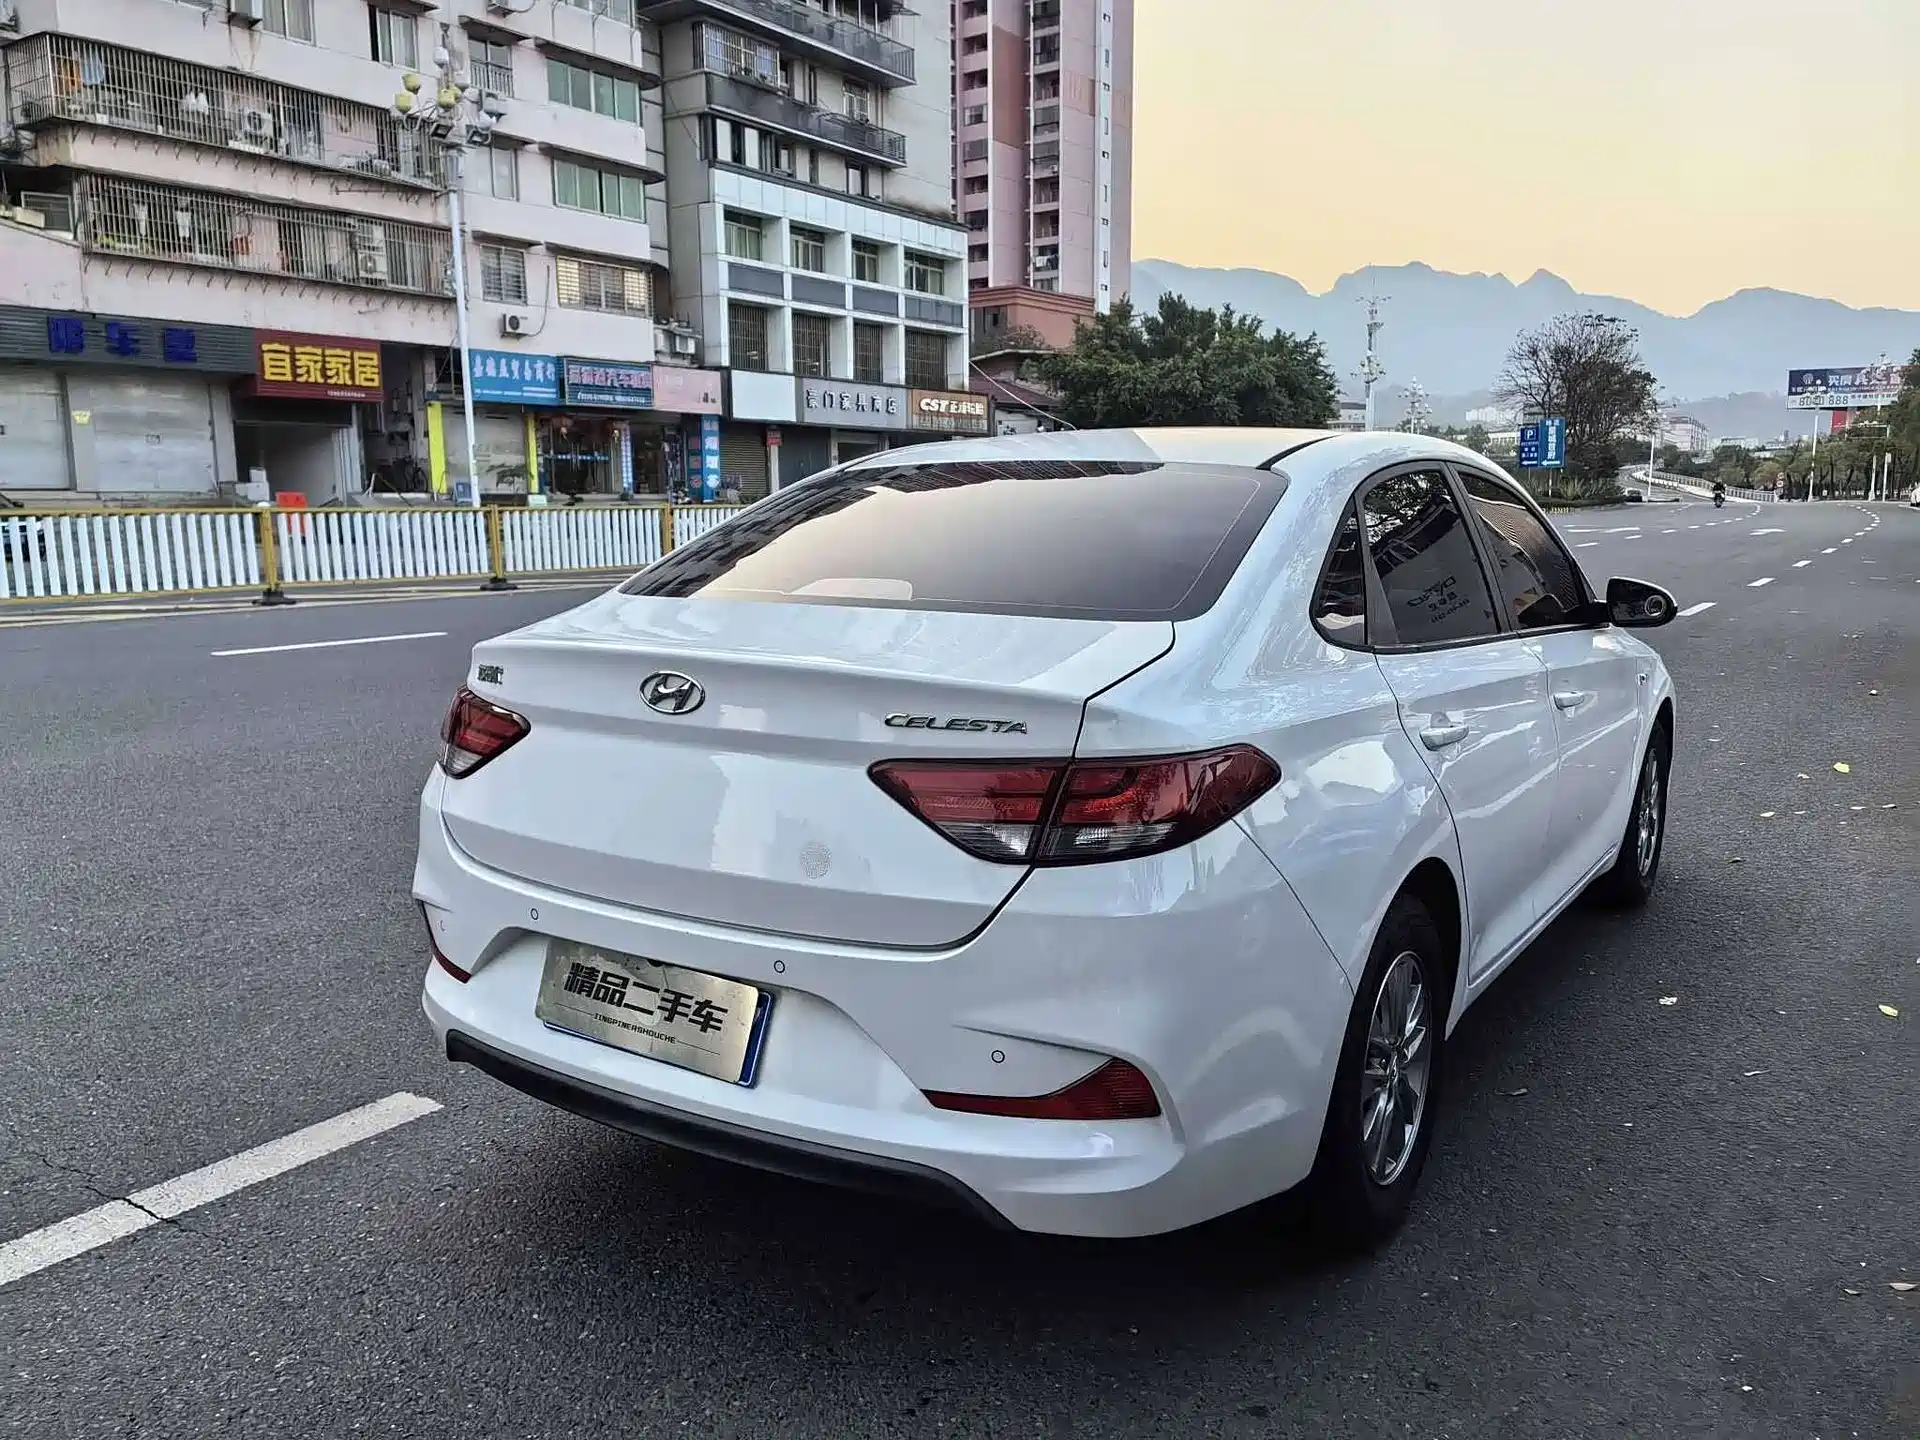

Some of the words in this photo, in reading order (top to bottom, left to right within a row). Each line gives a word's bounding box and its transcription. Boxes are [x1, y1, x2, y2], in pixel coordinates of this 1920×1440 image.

[261, 342, 381, 387] 宜家家居
[919, 397, 949, 412] CST
[883, 711, 1030, 736] CELESTA
[563, 961, 729, 1034] 精品二手车
